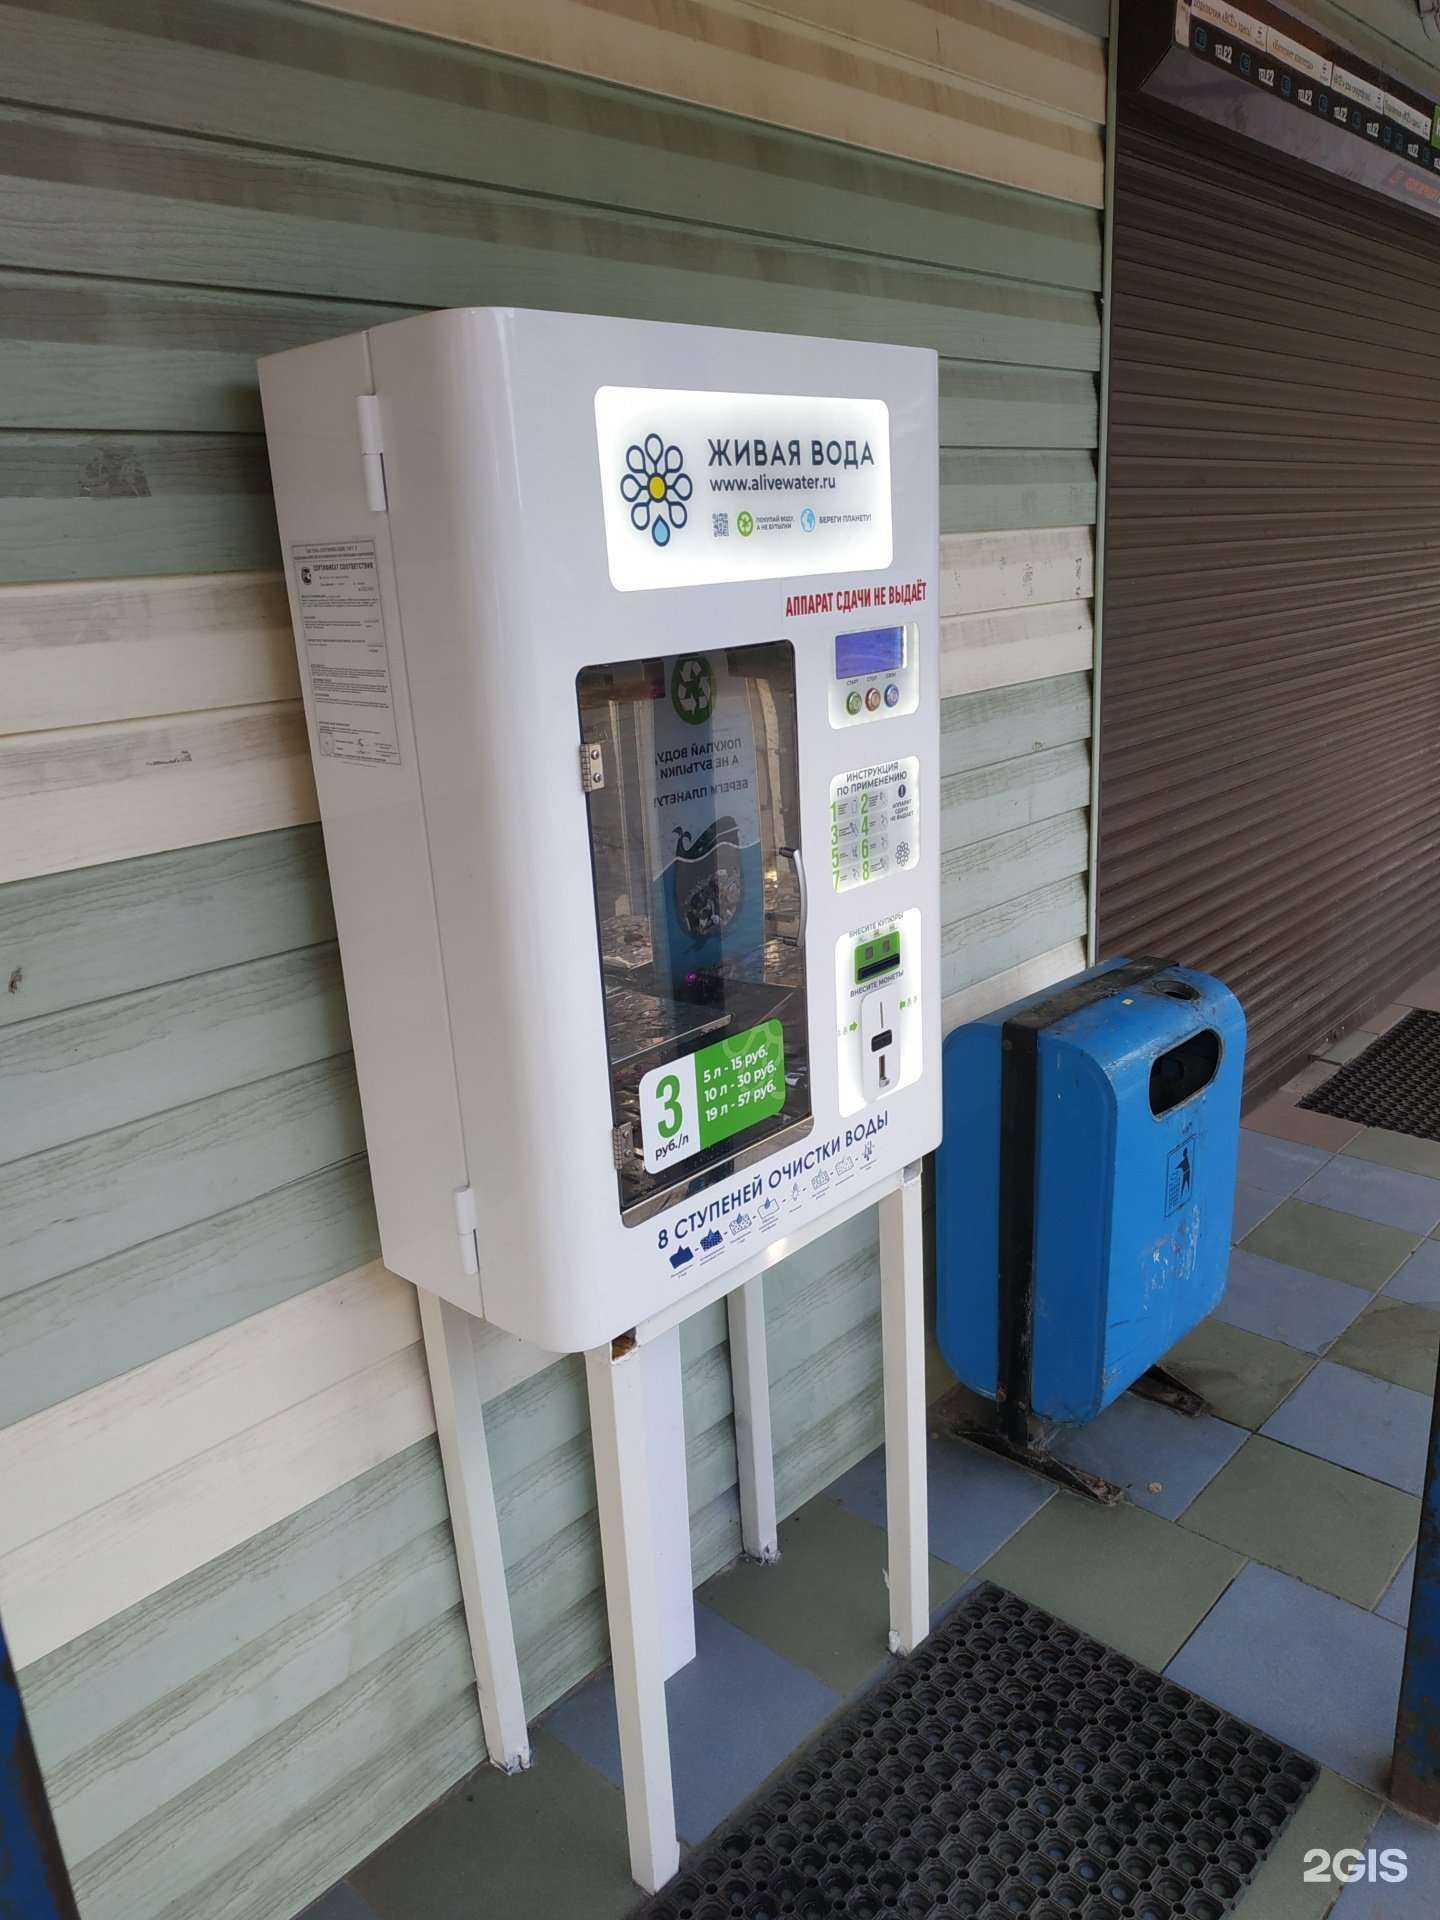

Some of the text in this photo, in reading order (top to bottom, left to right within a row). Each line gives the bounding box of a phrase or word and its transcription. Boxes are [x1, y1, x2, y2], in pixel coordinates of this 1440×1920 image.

[707, 438, 875, 470] ЖИВАЯ ВОДА
[709, 473, 837, 492] www.alivewater.ru
[819, 514, 872, 524] БЕРЕГИ ПЛАНЕТУ!
[785, 579, 927, 617] АППАРАТ СДАЧИ НЕ ВЫДАЁТ
[836, 770, 908, 797] ПО ПРИМЕНЕНИЮ
[846, 761, 899, 783] ИНСТРУКЦИЯ
[831, 801, 836, 822] 1
[861, 793, 869, 815] 2
[831, 825, 838, 845] 3
[861, 815, 869, 836] 4
[831, 847, 839, 868] 5
[861, 839, 869, 859] 6
[832, 870, 840, 890] 7
[862, 860, 870, 881] 8
[848, 922, 877, 938] ВНЕСИТЕ
[877, 911, 904, 928] КУПЮРЫ
[850, 969, 904, 998] ВНЕСИТЕ МОНЕТЫ
[703, 1068, 711, 1083] 5
[713, 1067, 721, 1079] л
[730, 1057, 742, 1071] 15
[744, 1044, 769, 1066] руб.
[704, 1088, 717, 1102] 10
[719, 1084, 728, 1096] л
[737, 1073, 751, 1088] 30
[753, 1060, 777, 1081] руб.
[655, 1074, 683, 1138] 3
[705, 1106, 718, 1122] 19
[719, 1104, 728, 1116] л
[737, 1093, 751, 1108] 57
[753, 1079, 777, 1102] руб.
[655, 1134, 689, 1161] руб./л
[657, 1110, 889, 1249] 8 СТУПЕНЕЙ ОЧИСТКИ ВОДЫ
